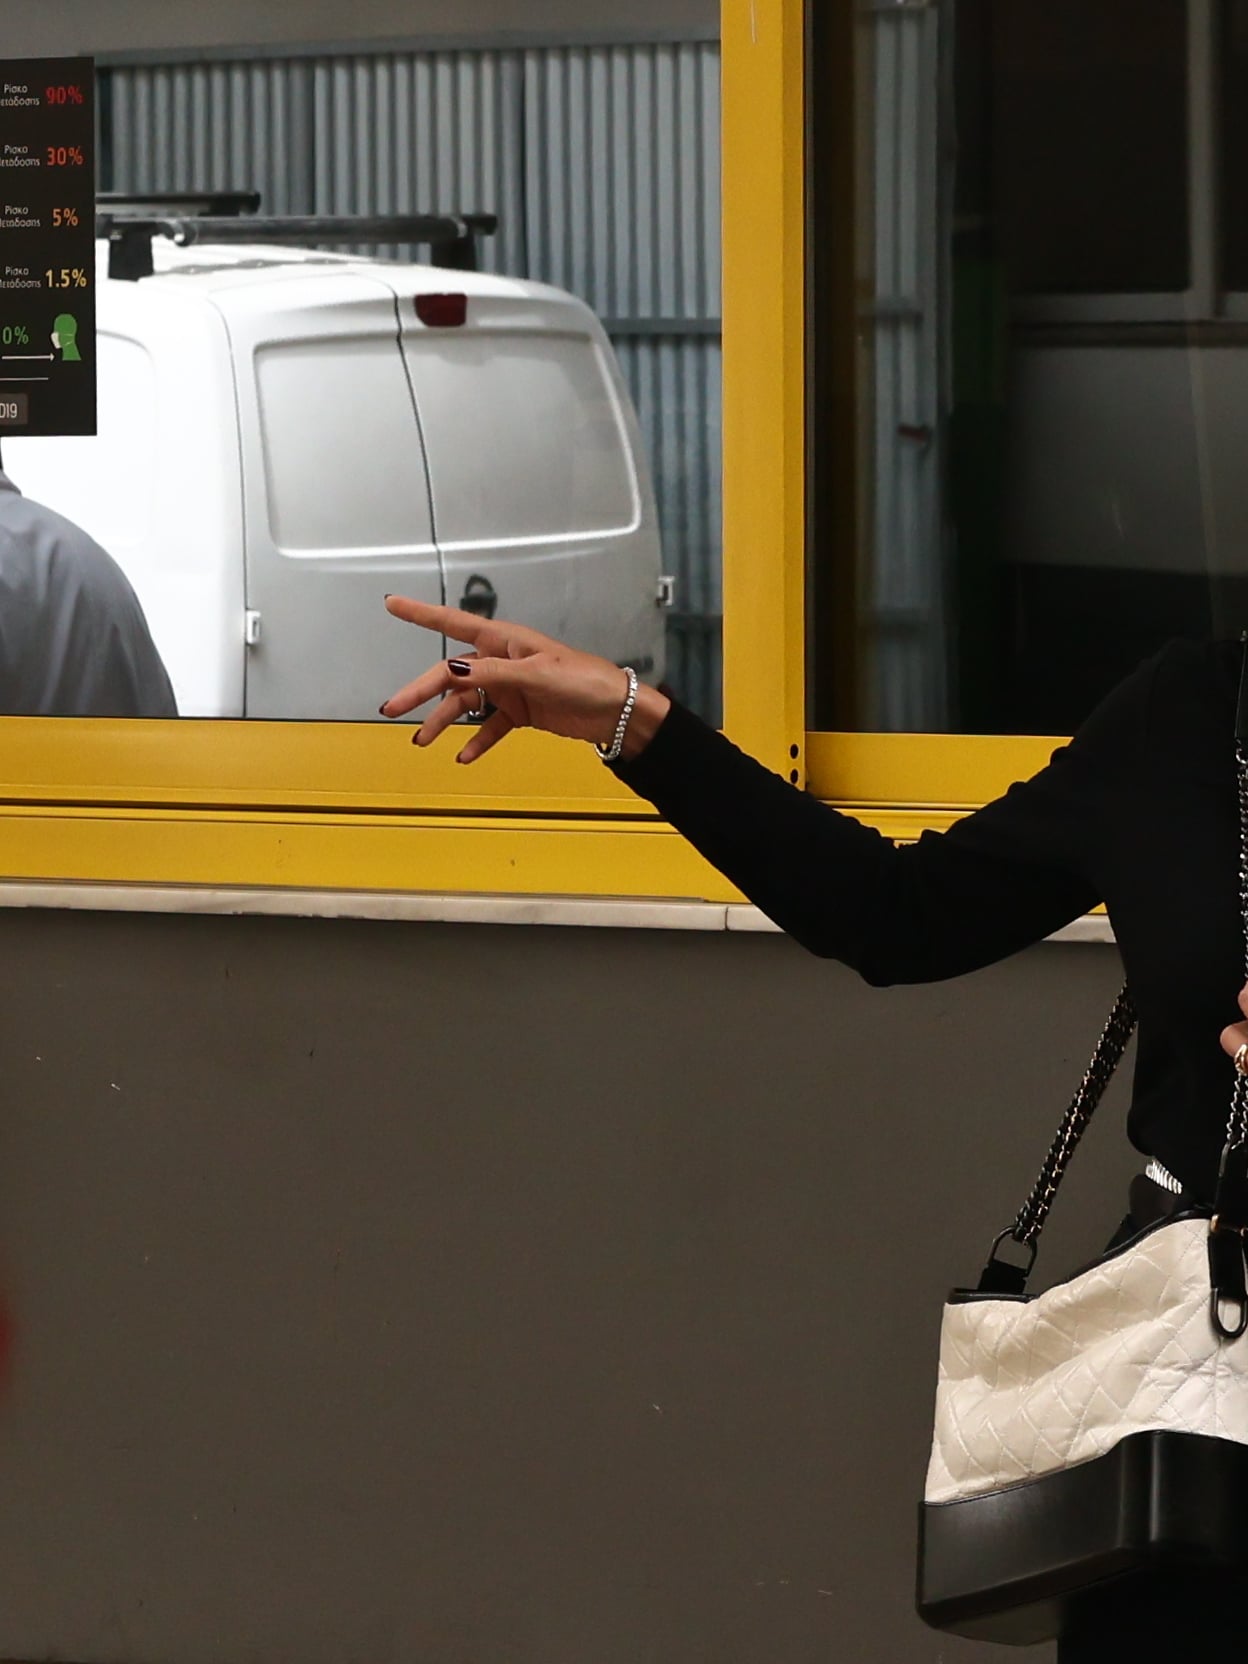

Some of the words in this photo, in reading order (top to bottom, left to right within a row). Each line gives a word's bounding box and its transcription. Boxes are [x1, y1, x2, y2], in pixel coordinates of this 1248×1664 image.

[46, 86, 84, 105] 90%
[47, 146, 84, 166] 30%
[53, 208, 79, 226] 5%
[45, 268, 87, 288] 1.5%
[2, 326, 29, 345] 0%
